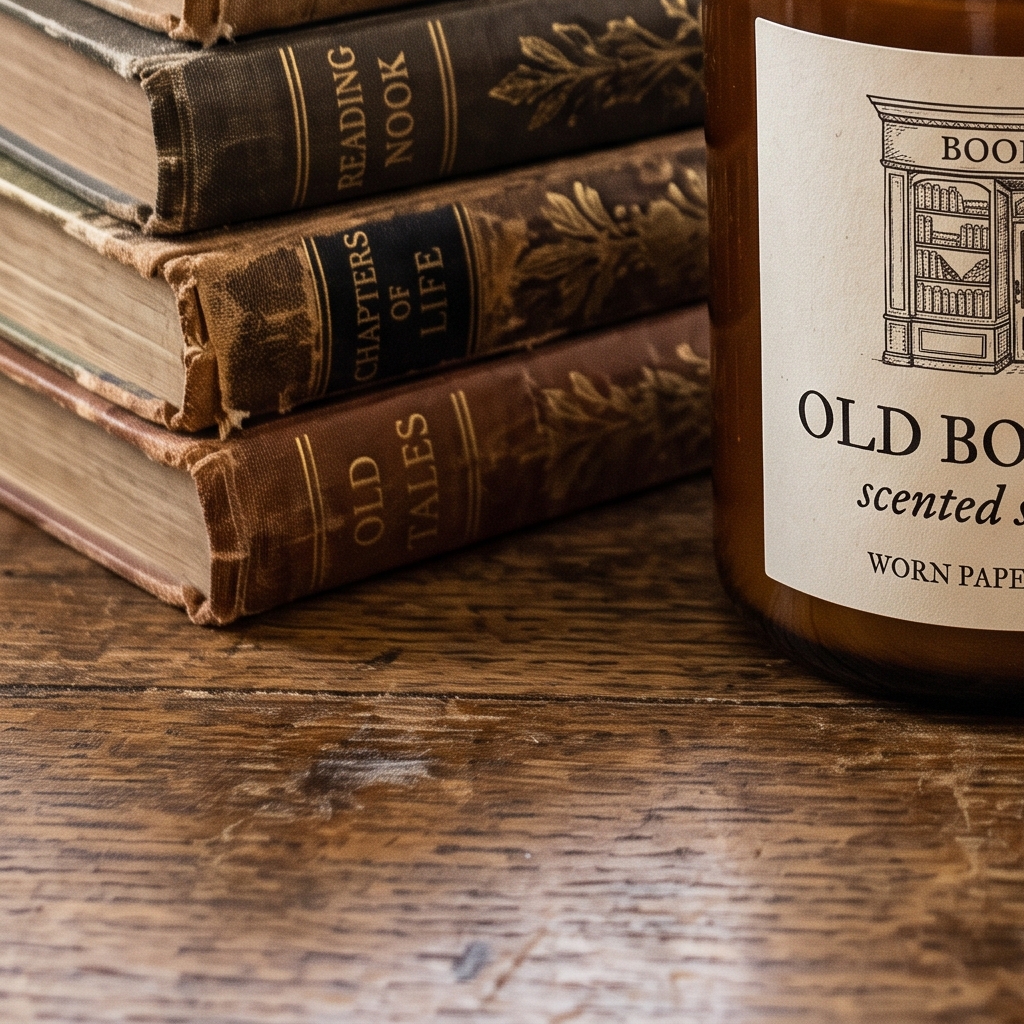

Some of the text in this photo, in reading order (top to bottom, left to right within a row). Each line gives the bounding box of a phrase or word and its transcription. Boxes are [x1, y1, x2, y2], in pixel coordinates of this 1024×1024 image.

[328, 45, 366, 190] READING
[377, 50, 414, 167] NOOK
[343, 230, 381, 382] CHAPTERS
[389, 285, 411, 321] OF
[414, 246, 449, 337] LIFE
[798, 389, 922, 457] OLD
[349, 456, 385, 546] OLD
[395, 413, 439, 551] TALES
[856, 483, 1007, 526] scented
[867, 551, 952, 585] WORN
